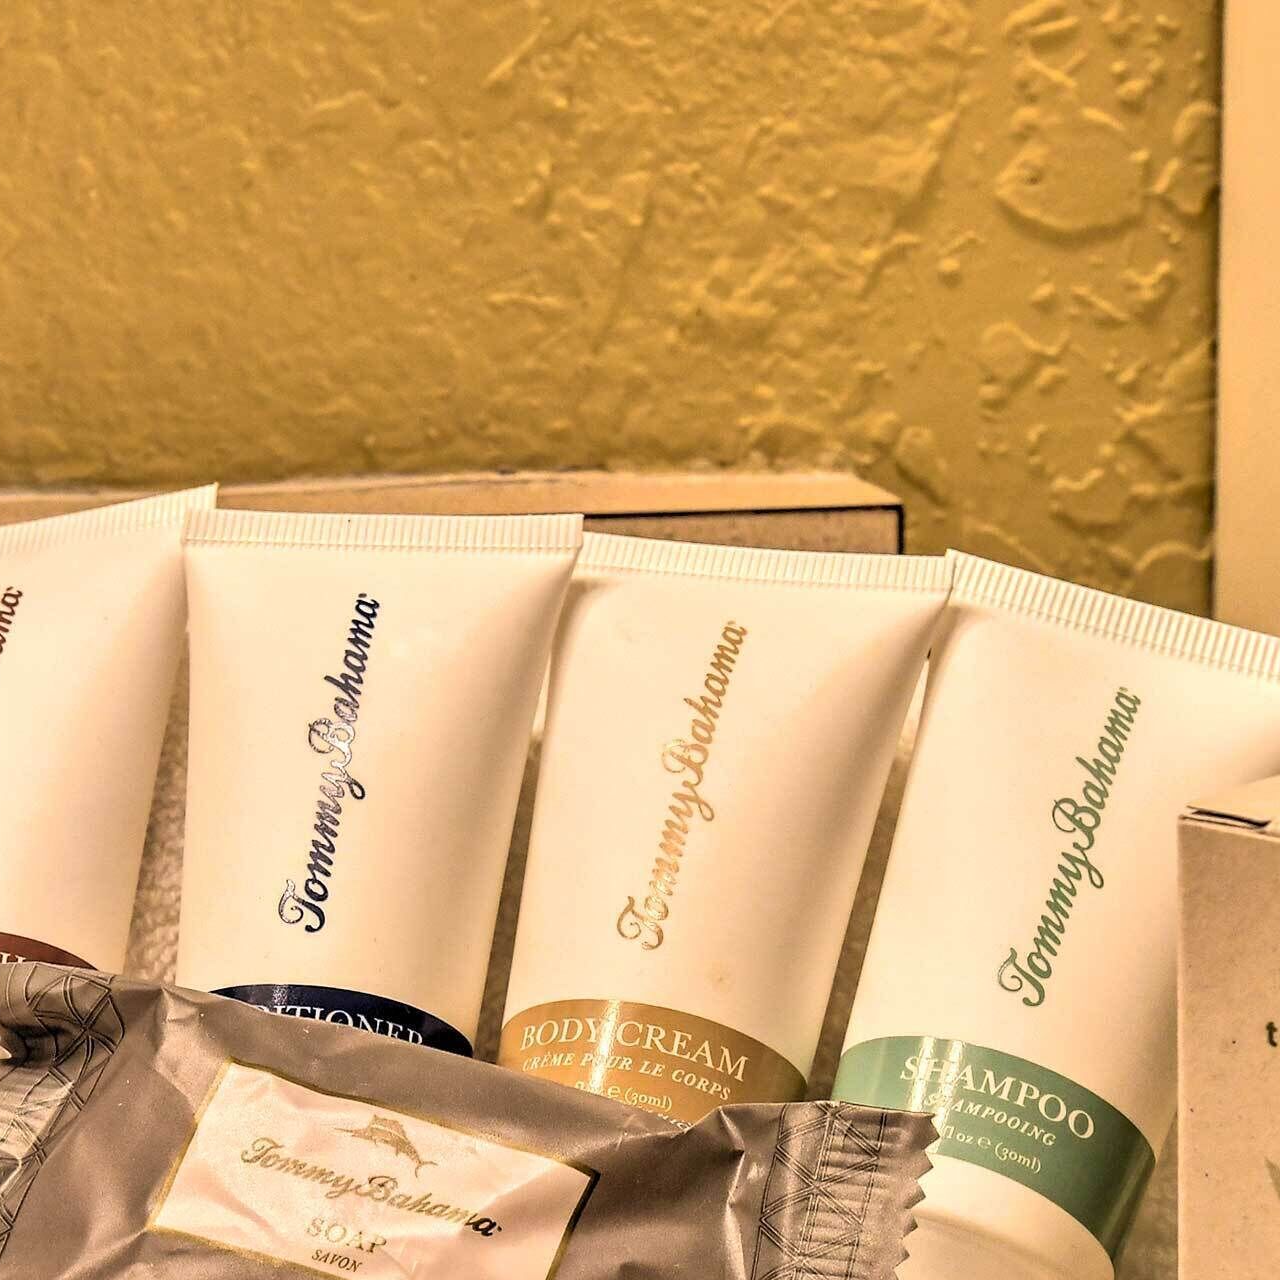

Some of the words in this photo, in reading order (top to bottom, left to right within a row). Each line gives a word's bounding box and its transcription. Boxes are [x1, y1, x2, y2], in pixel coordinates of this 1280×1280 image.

[520, 1017, 603, 1051] BODY
[616, 1020, 749, 1083] CREAM
[523, 1052, 574, 1072] CRÈME
[580, 1052, 633, 1071] PUR
[639, 1060, 666, 1078] LE
[671, 1069, 732, 1101] CORPS
[899, 1055, 1096, 1140] SHAMPOO
[924, 1091, 1057, 1147] SAMPOOING
[956, 1132, 974, 1145] oz
[994, 1142, 1042, 1174] (30ml)
[306, 1216, 387, 1254] SOAP
[311, 1248, 363, 1273] SAVON
